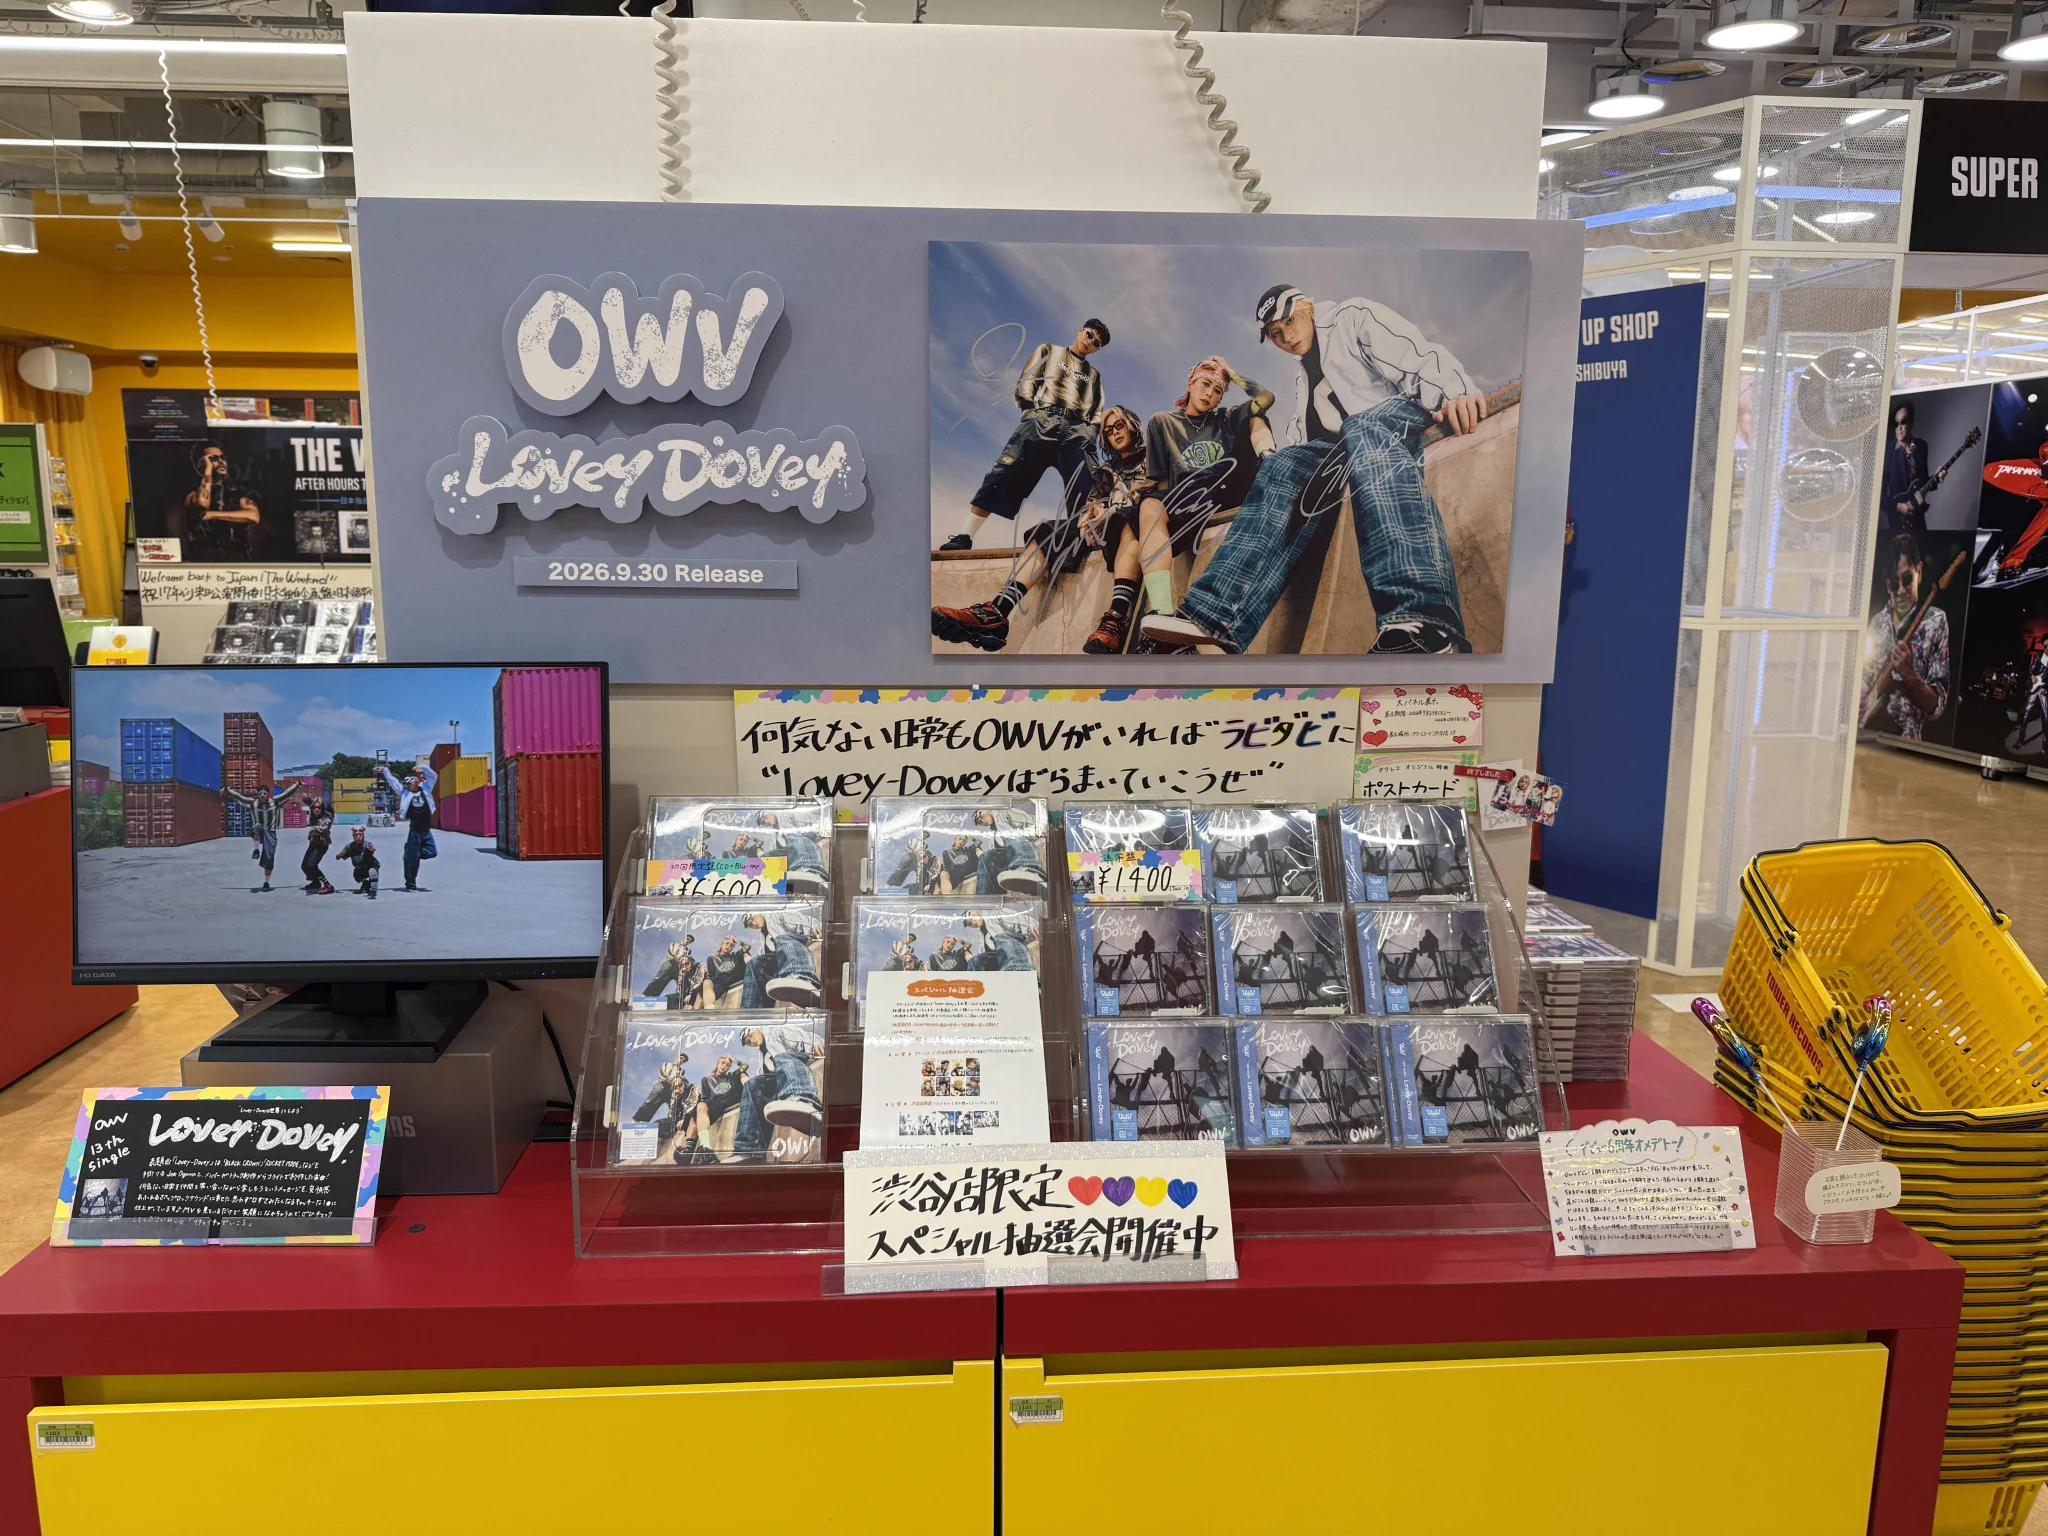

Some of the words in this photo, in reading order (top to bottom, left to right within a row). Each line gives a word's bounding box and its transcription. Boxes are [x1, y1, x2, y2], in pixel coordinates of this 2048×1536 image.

[1951, 156, 2039, 199] SUPER
[1582, 317, 1606, 347] UP
[1610, 310, 1660, 344] SHOP
[517, 288, 769, 401] OWV
[1576, 359, 1628, 383] SHIBUYA
[290, 437, 343, 472] THE
[295, 477, 325, 491] AFTER
[327, 477, 360, 491] HOURS
[140, 571, 184, 584] Welcome
[188, 571, 212, 582] back
[548, 562, 668, 582] 2026.9.30
[675, 564, 764, 584] Release
[1363, 779, 1460, 797] ポストカード
[1766, 969, 1790, 1018] TOWER
[1788, 1015, 1824, 1076] RECORDS
[1350, 1125, 1379, 1142] OWV
[1612, 1128, 1637, 1136] OWV
[867, 1215, 1220, 1263] スペシャル抽選会開催中
